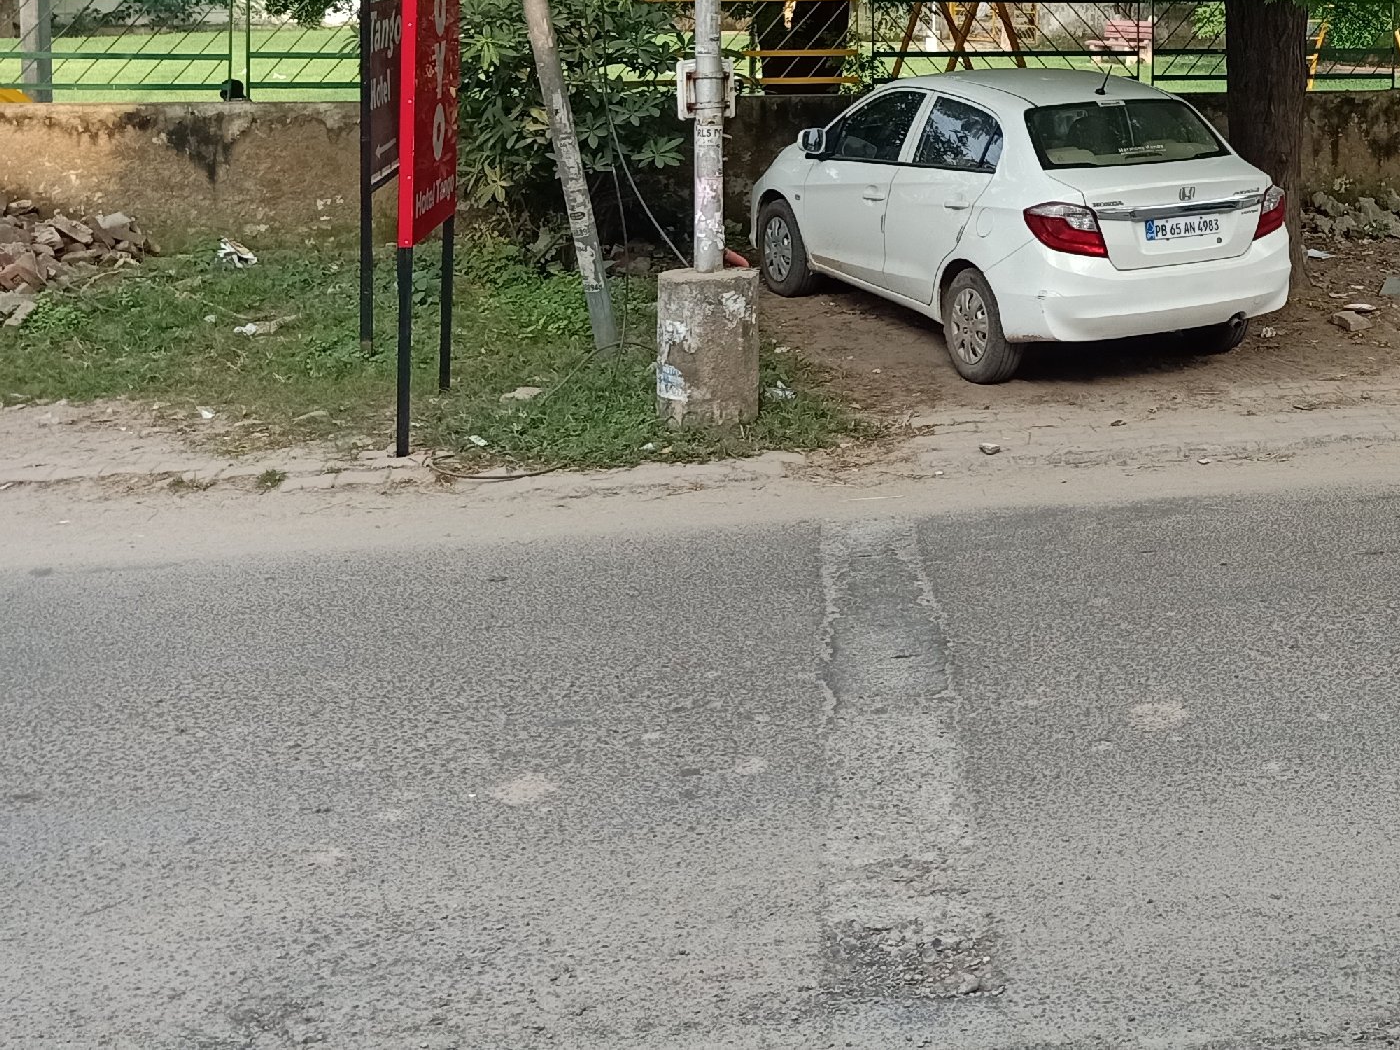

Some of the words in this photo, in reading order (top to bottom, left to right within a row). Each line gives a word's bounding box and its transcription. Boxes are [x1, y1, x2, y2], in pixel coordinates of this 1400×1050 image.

[370, 9, 402, 59] Tango
[370, 67, 391, 111] Hotel
[415, 183, 435, 219] Hotel
[435, 173, 455, 204] Tango
[1155, 223, 1167, 237] PB
[1169, 222, 1182, 236] 65
[1184, 221, 1196, 234] AN
[1197, 218, 1220, 233] 4983
